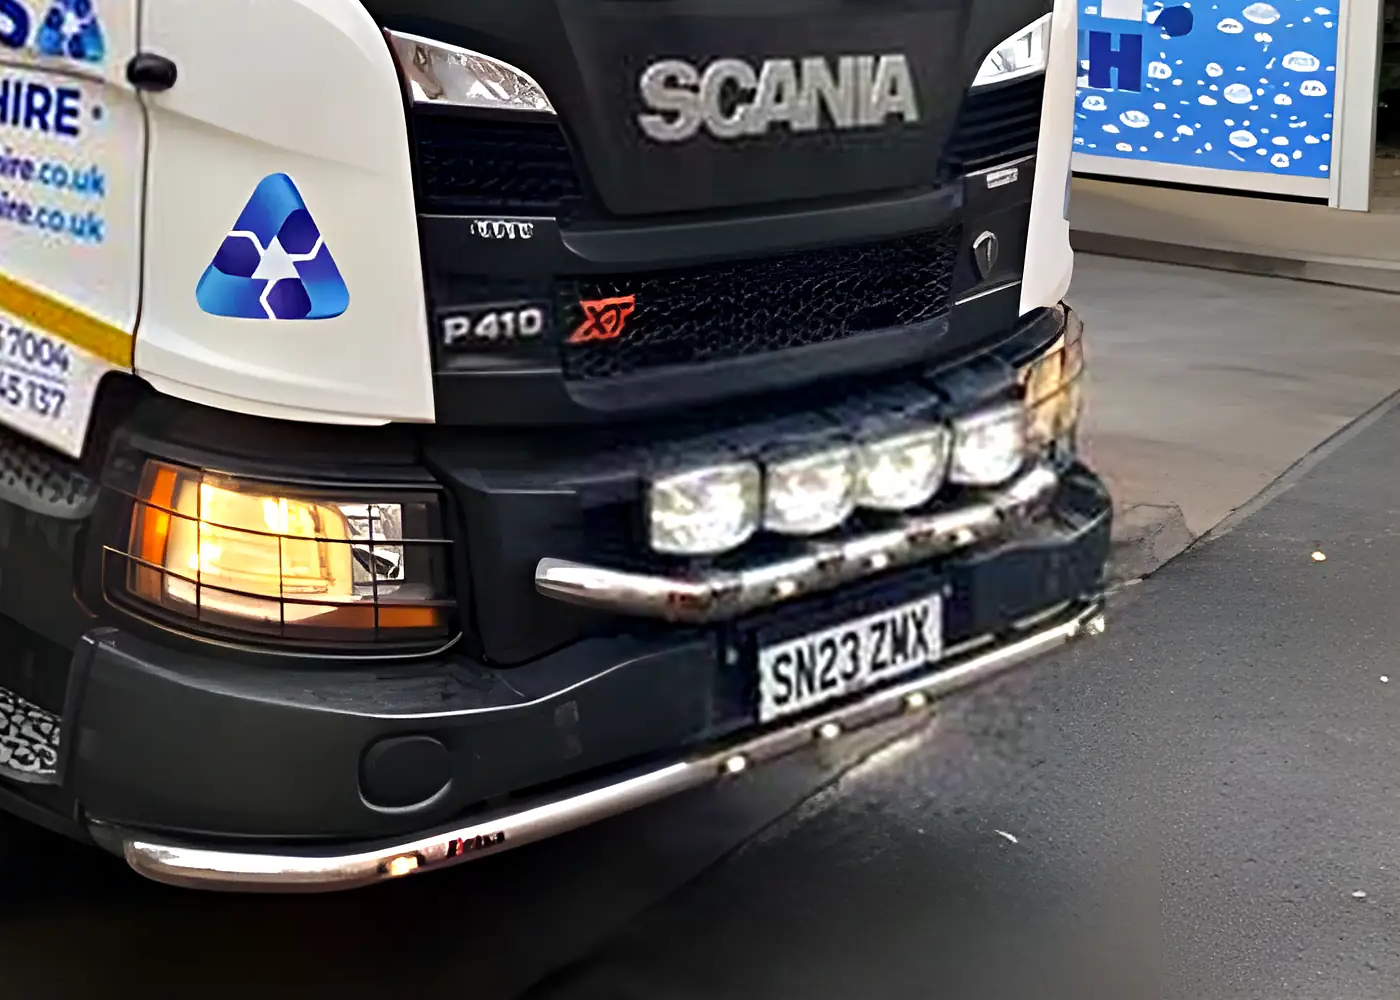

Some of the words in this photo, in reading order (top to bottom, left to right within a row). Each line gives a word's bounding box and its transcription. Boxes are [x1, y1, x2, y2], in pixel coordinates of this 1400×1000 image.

[638, 53, 922, 142] SCANIA
[7, 327, 70, 371] 7004
[771, 631, 861, 706] SN23
[869, 605, 929, 672] ZMX
